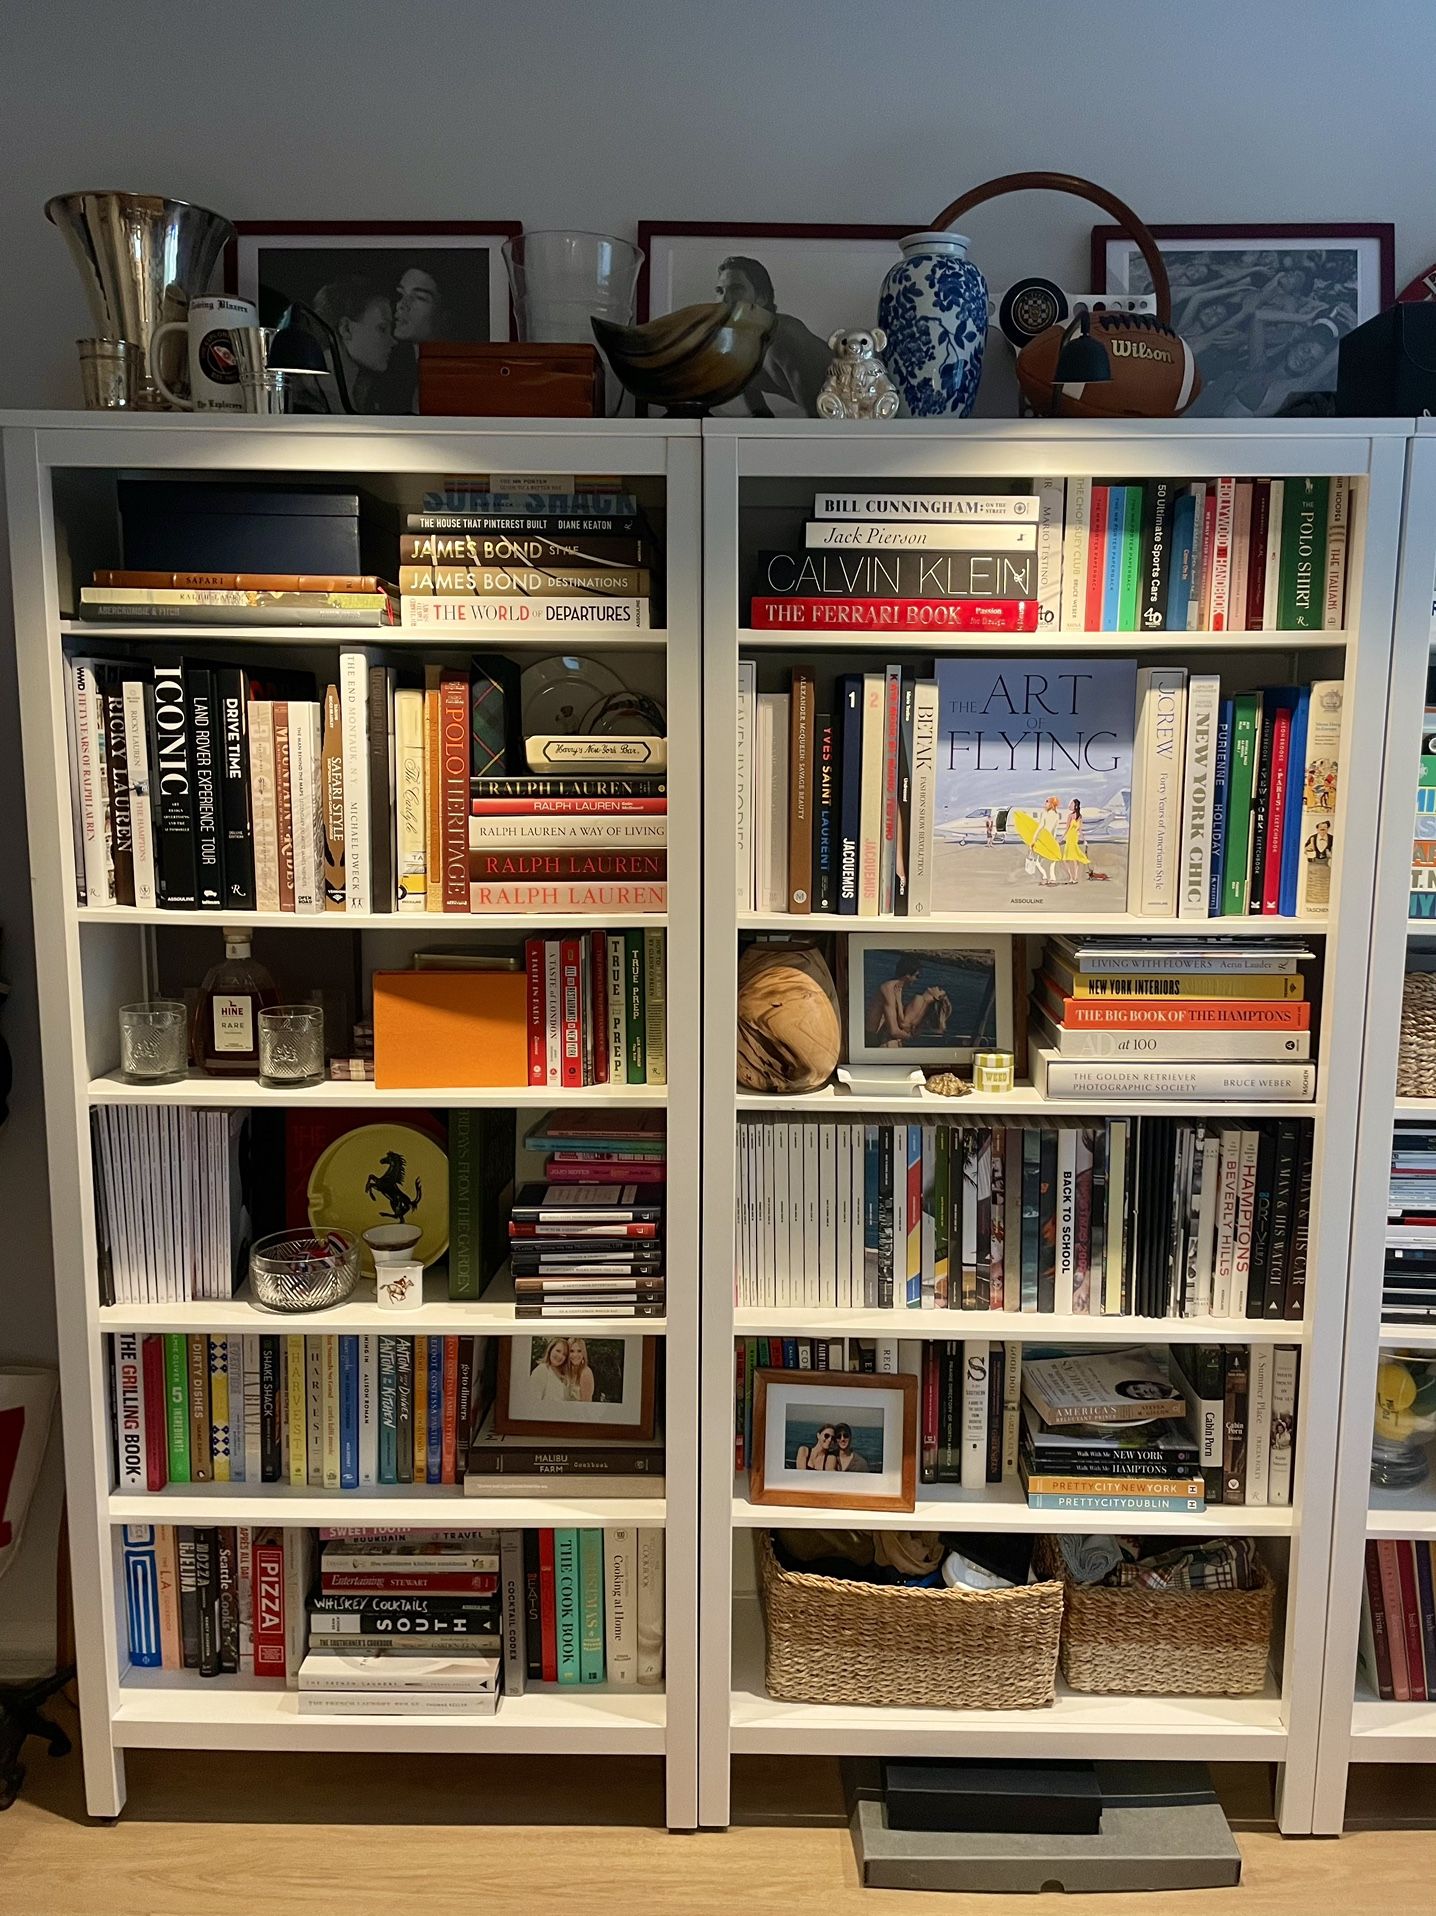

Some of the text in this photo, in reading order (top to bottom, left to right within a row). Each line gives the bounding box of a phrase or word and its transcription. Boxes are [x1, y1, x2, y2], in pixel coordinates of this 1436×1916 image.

[1111, 339, 1173, 364] Wilson
[420, 518, 547, 529] THE HOUSE THAT PINTEREST BUILT
[558, 520, 612, 530] DIANE KEATON
[824, 499, 983, 514] BILL CUNNINGHAM:
[411, 540, 579, 559] JAMES BOND STYLE
[824, 526, 927, 545] Jack Pierson
[1041, 506, 1051, 585] MARIO TESTINO
[1149, 484, 1166, 602] 50 Ultimate Sports Cars
[1213, 483, 1231, 615] HOLLYWOOD HANDBOOK
[185, 576, 224, 585] SAFARI
[410, 573, 627, 590] JAMES BOND DESTINATIONS
[767, 554, 1030, 595] CALVIN KLEIN
[1296, 511, 1314, 609] POLO SHIRT
[1327, 549, 1340, 610] THE ITALIANS
[433, 604, 466, 621] THE
[471, 604, 529, 621] WORLD
[546, 605, 631, 621] DEPARTURES
[765, 604, 962, 625] THE FERRARI BOOK
[949, 673, 1093, 715] THE ART
[153, 665, 189, 796] ICONIC
[226, 697, 242, 779] DRIVE TIME
[916, 706, 933, 771] BETAK
[1026, 717, 1045, 729] OF
[1156, 681, 1175, 760] J.CREW
[946, 730, 1121, 772] FLYING
[108, 695, 132, 852] RICKY LAUREN
[193, 697, 216, 865] LAND ROVER EXPERIENCE TOUR
[488, 781, 633, 794] RALPH LAUREN
[1211, 723, 1227, 856] PURIENNE HOLIDAY
[331, 756, 343, 841] SAFARI STYLE
[444, 706, 466, 894] POLO HERITAGE
[533, 801, 620, 811] RALPH LAUREN
[820, 727, 832, 872] YVES SAINT LAURENT
[1187, 712, 1210, 902] NEW YORK CHIC
[350, 802, 360, 890] MICHAEL DWECK
[479, 826, 665, 836] RALPH LAUREN A WAY OF LIVING
[1154, 772, 1168, 890] Forty Years of American Style
[486, 856, 659, 873] RALPH LAUREN
[841, 837, 856, 899] JACQUEMUS
[863, 837, 876, 899] JACQUEMUS
[479, 887, 665, 905] RALPH LAUREN
[1088, 979, 1180, 995] NEW YORK INTERIORS
[220, 1007, 244, 1016] HINE
[221, 1021, 245, 1029] RARE
[1075, 1009, 1291, 1022] THE BIG BOOK OF THE HAMPTONS
[985, 1071, 1007, 1082] WEED
[1073, 1072, 1196, 1081] THE GOLDEN RETRIEVER
[1073, 1083, 1198, 1092] PHOTOGRAPHIC SOCIETY
[1223, 1079, 1291, 1087] BRUCE WEBER
[1061, 1171, 1072, 1274] BACK TO SCHOOL
[1219, 1160, 1237, 1277] BEVERLY HILLS
[1236, 1164, 1256, 1273] HAMPTONS
[192, 1343, 203, 1418] DIRTY DISHES
[263, 1350, 273, 1416] SHAKE SHACK
[379, 1336, 396, 1428] ANTONI KITCHEN
[396, 1337, 411, 1422] ANTONI DINNER
[120, 1333, 141, 1475] THE GRILLING BOOK
[460, 1386, 470, 1420] dinners
[1055, 1406, 1117, 1416] AMERICA'S
[1113, 1450, 1136, 1460] NEW
[1137, 1451, 1163, 1460] YORK
[1204, 1412, 1215, 1456] Cabin Porn
[535, 1454, 568, 1462] MALIBU
[1058, 1497, 1169, 1508] PRETTYCITYDUBLIN
[179, 1542, 196, 1592] GJELINA
[195, 1543, 210, 1586] MOZZA
[331, 1574, 428, 1587] Entertaining STEWART
[218, 1548, 233, 1629] Seattle Cooks
[260, 1562, 280, 1628] PIZZA
[559, 1539, 574, 1664] THE COOK BOOK
[612, 1555, 624, 1641] Cooking at Home
[376, 1617, 467, 1631] SOUTH
[507, 1581, 517, 1660] COCKTAIL CODEX
